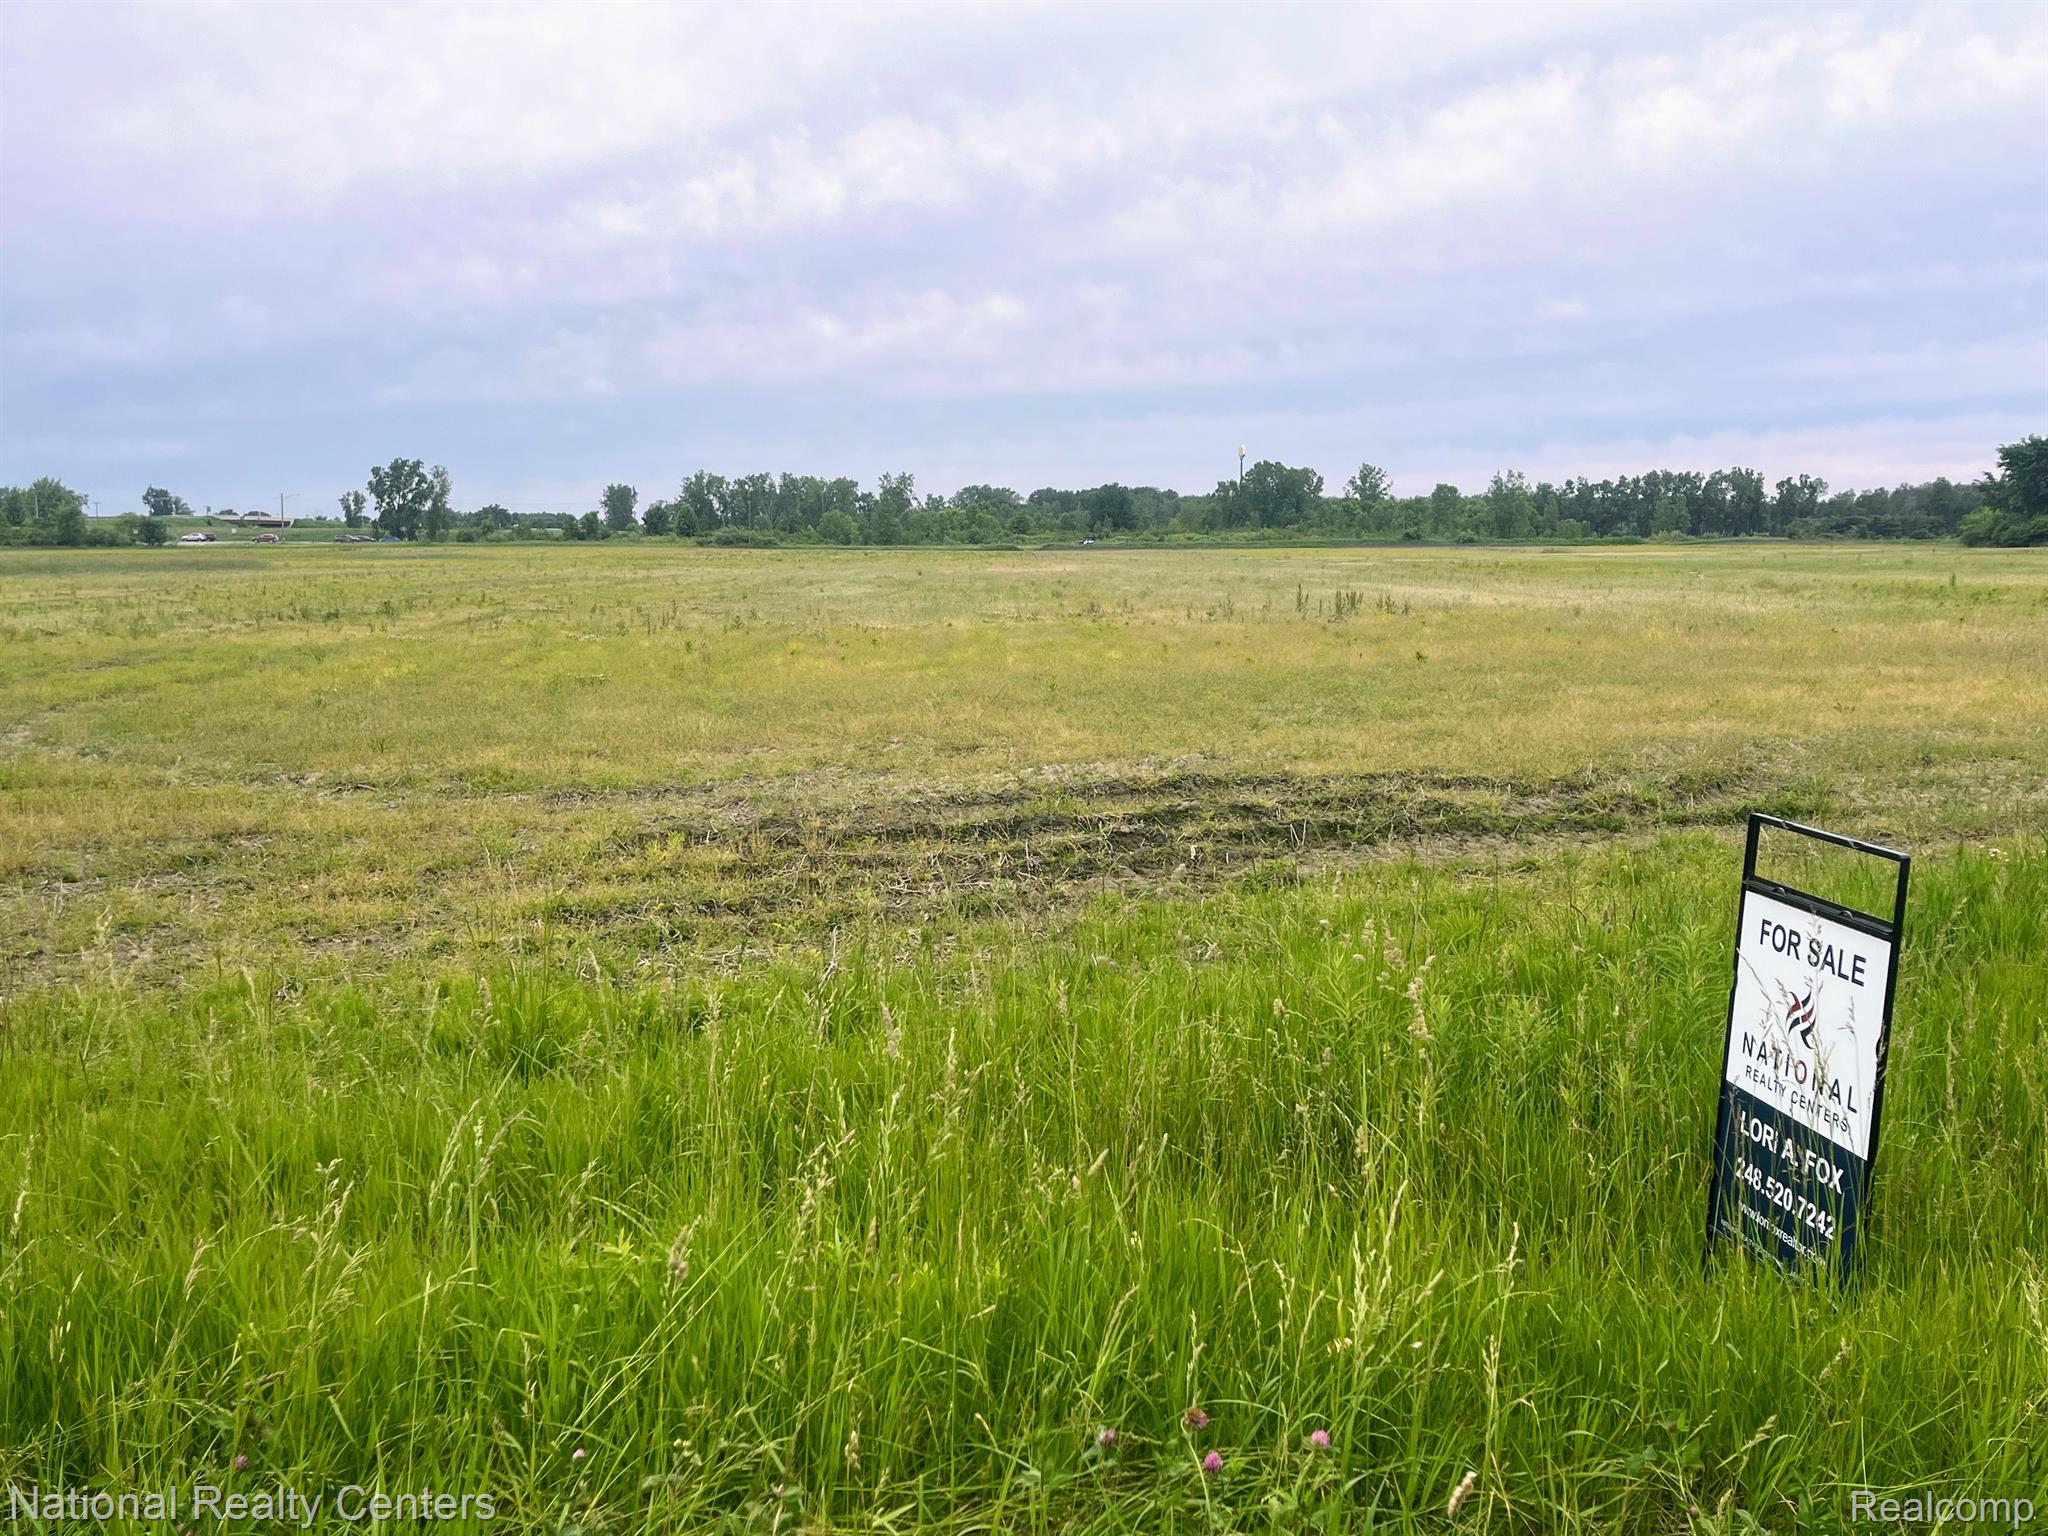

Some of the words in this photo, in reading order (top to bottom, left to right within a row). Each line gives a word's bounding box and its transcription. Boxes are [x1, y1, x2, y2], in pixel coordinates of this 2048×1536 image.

[1759, 918, 1801, 960] FOR
[1807, 937, 1867, 987] SALE
[1742, 1031, 1858, 1114] NATIONAL
[1745, 1064, 1787, 1097] REALTY
[1791, 1090, 1848, 1132] CENTERS
[1740, 1110, 1779, 1153] LORI
[1804, 1149, 1844, 1195] FOX
[1735, 1156, 1835, 1240] 248.520.7242
